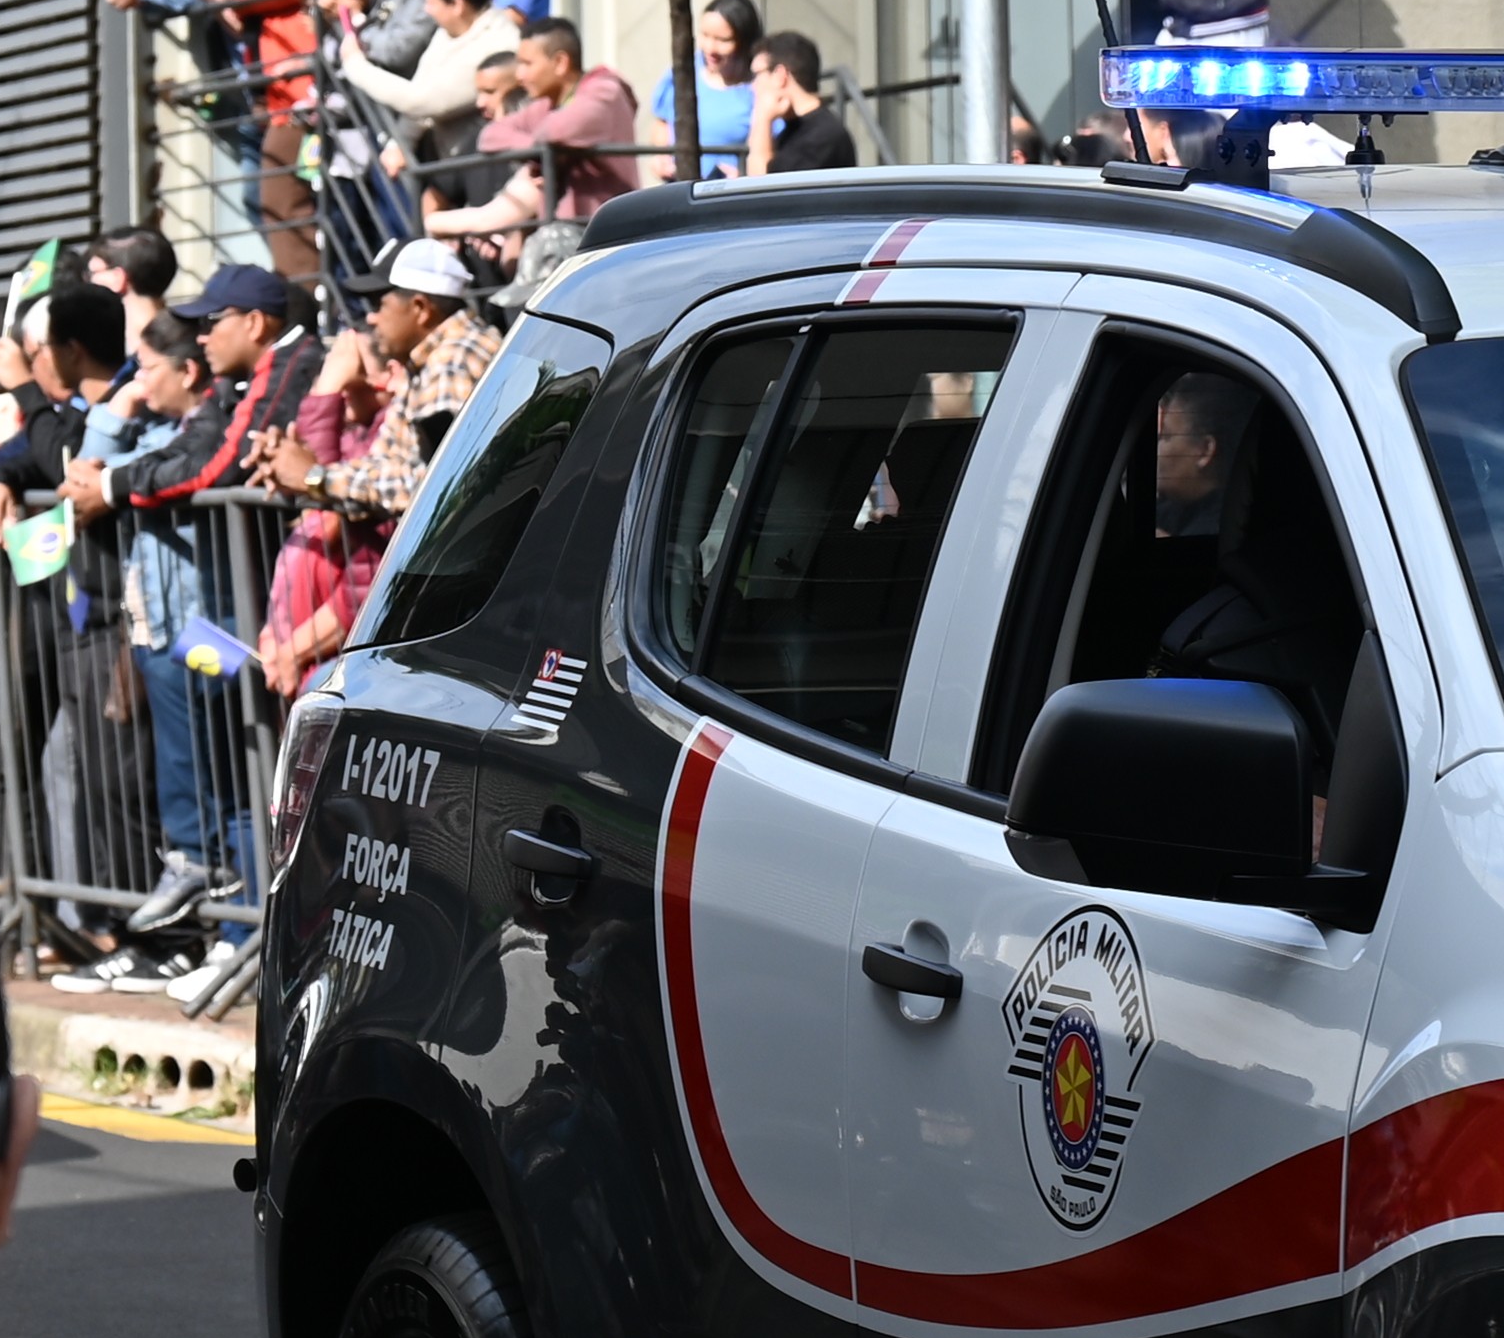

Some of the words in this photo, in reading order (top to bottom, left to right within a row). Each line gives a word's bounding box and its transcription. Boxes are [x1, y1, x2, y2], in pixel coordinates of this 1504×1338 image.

[341, 734, 441, 808] I-12017
[341, 833, 411, 903] FORÇA
[328, 901, 395, 970] TÁTICA
[1011, 919, 1090, 1031] POLÍCIA
[1093, 922, 1145, 1058] MILITAR
[1049, 1185, 1067, 1214] SÃO
[1068, 1195, 1097, 1219] PAULO
